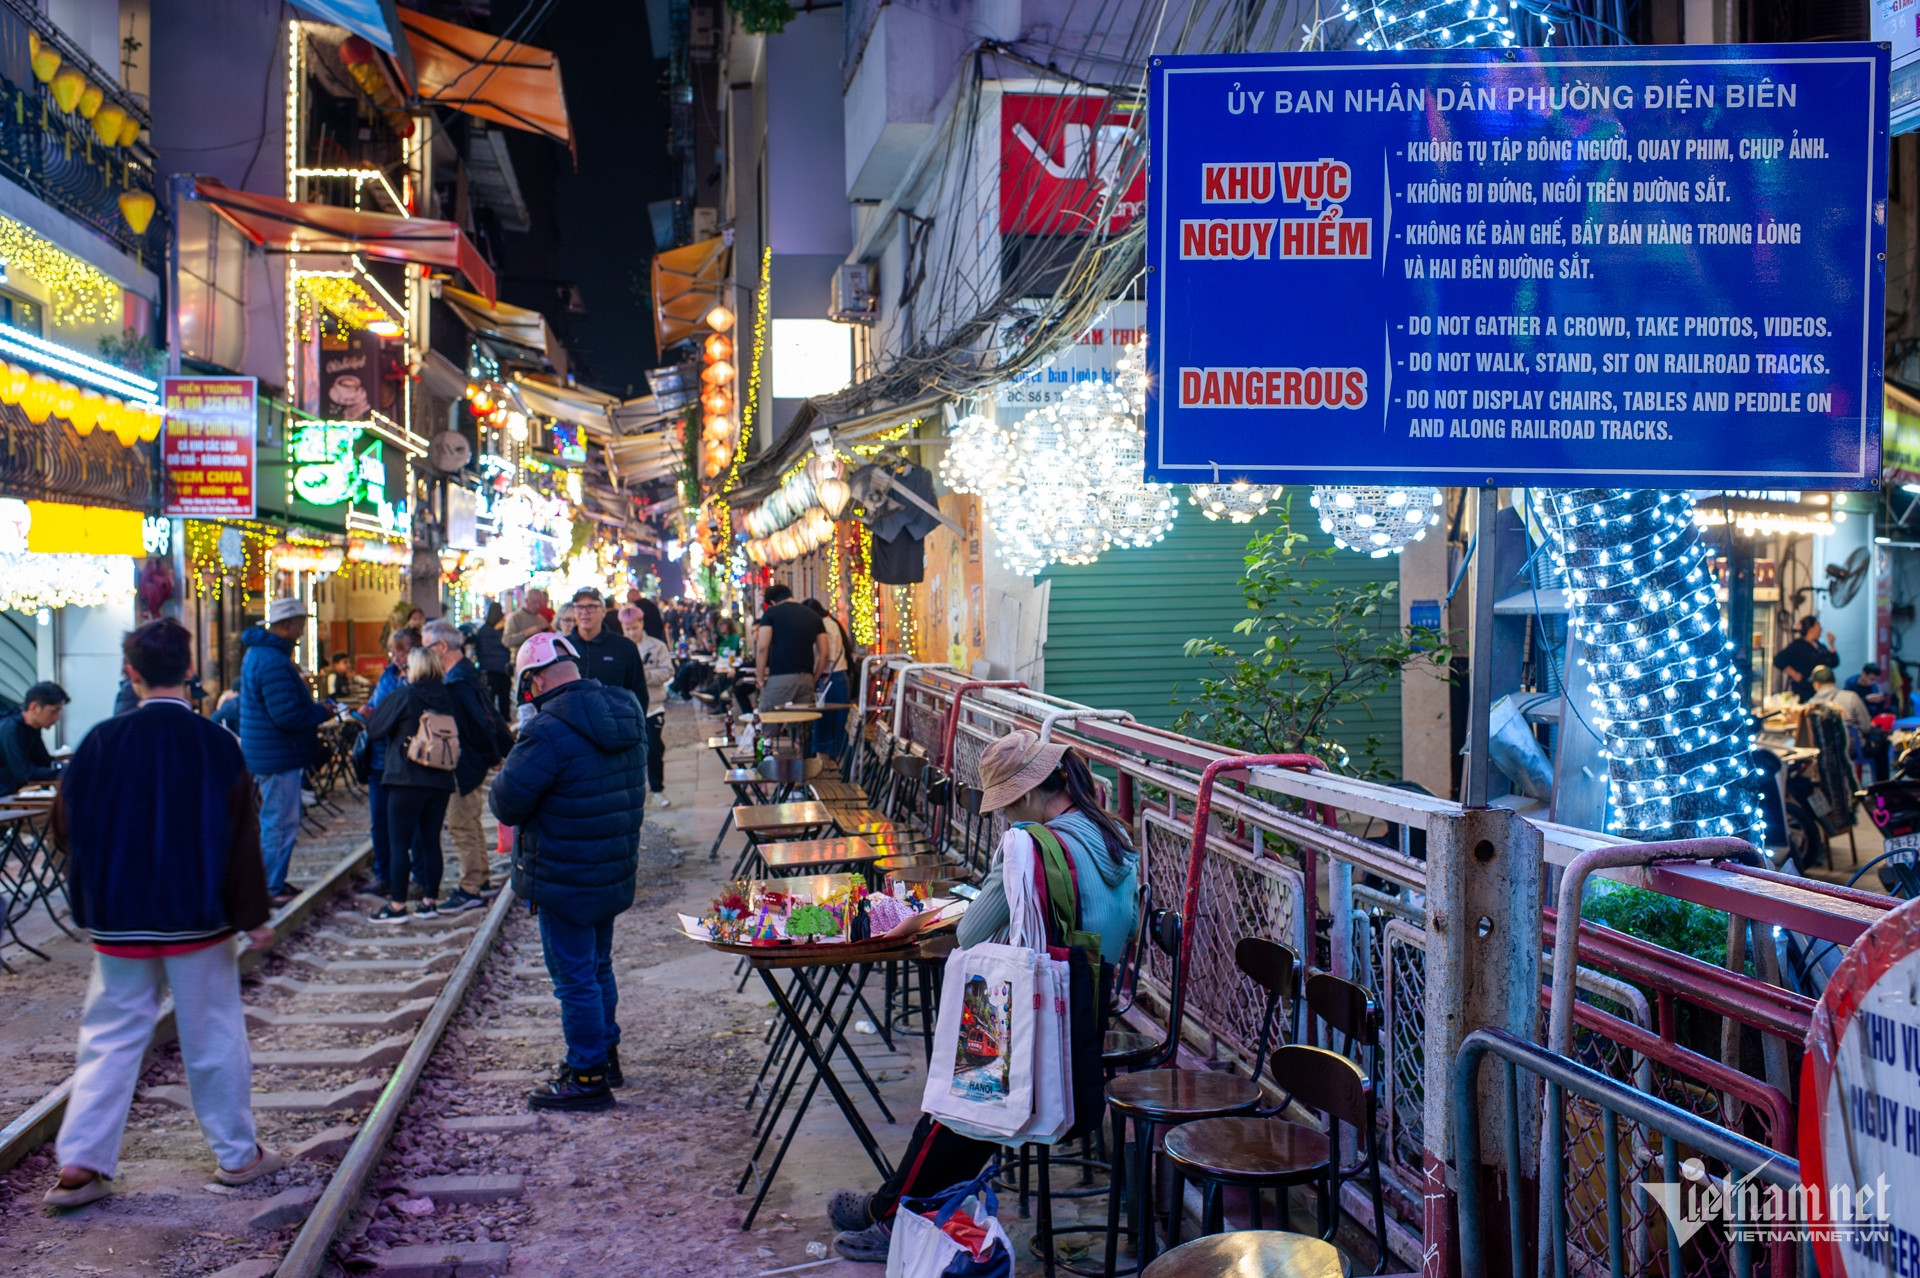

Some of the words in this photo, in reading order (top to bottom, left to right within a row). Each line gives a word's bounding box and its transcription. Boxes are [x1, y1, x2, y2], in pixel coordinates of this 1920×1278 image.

[1228, 82, 1265, 115] ỦY
[1275, 90, 1334, 113] BAN
[1345, 82, 1425, 112] NHÂN
[1436, 81, 1496, 111] DÂN
[1507, 79, 1634, 111] PHƯỜNG
[1644, 78, 1714, 114] ĐIỆN
[1726, 77, 1797, 108] BIÊN
[1407, 137, 1463, 162] KHÔNG
[1467, 140, 1487, 166] TỤ
[1491, 136, 1523, 166] TẬP
[1526, 136, 1573, 162] ĐÔNG
[1577, 134, 1633, 163] NGƯỜI,
[1637, 139, 1681, 163] QUAY
[1685, 138, 1734, 163] PHIM,
[1739, 138, 1785, 164] CHỤP
[1788, 129, 1830, 160] ẢNH.
[1203, 165, 1273, 202] KHU
[1281, 161, 1349, 207] VỰC
[1406, 179, 1462, 204] KHÔNG
[1466, 182, 1483, 203] ĐI
[1487, 176, 1537, 206] ĐỨNG,
[1542, 174, 1582, 203] NGỒI
[1586, 177, 1629, 203] TRÊN
[1632, 175, 1690, 203] ĐƯỜNG
[1694, 174, 1731, 203] SẮT.
[1183, 222, 1274, 257] NGUY
[1282, 207, 1369, 257] HIỂM
[1406, 219, 1461, 245] KHÔNG
[1466, 219, 1487, 245] KÊ
[1491, 218, 1525, 245] BÀN
[1530, 216, 1567, 248] GHẾ,
[1571, 216, 1604, 245] BẦY
[1608, 218, 1643, 245] BÁN
[1647, 218, 1693, 245] HÀNG
[1697, 223, 1753, 245] TRONG
[1757, 218, 1802, 245] LÒNG
[1404, 254, 1425, 279] VÀ
[1429, 258, 1457, 279] HAI
[1461, 254, 1494, 279] BÊN
[1498, 253, 1554, 279] ĐƯỜNG
[1559, 252, 1595, 279] SẮT.
[1408, 315, 1432, 336] DO
[1437, 315, 1471, 336] NOT
[1475, 315, 1541, 336] GATHER
[1545, 316, 1558, 336] A
[1563, 316, 1631, 339] CROWD,
[1635, 316, 1679, 337] TAKE
[1684, 316, 1758, 339] PHOTOS,
[1763, 316, 1833, 337] VIDEOS.
[1409, 352, 1432, 372] DO
[1437, 352, 1471, 372] NOT
[1475, 352, 1530, 375] WALK,
[1535, 352, 1597, 375] STAND,
[1602, 352, 1630, 373] SIT
[1634, 353, 1659, 373] ON
[1664, 353, 1750, 374] RAILROAD
[1755, 353, 1830, 375] TRACKS.
[1182, 370, 1364, 406] DANGEROUS
[1406, 389, 1429, 409] DO
[1434, 389, 1468, 410] NOT
[1472, 389, 1544, 410] DISPLAY
[1549, 390, 1618, 413] CHAIRS,
[1622, 391, 1688, 412] TABLES
[1692, 391, 1729, 412] AND
[1734, 392, 1801, 413] PEDDLE
[1806, 392, 1832, 413] ON
[1408, 418, 1445, 438] AND
[1449, 418, 1506, 439] ALONG
[1511, 419, 1595, 440] RAILROAD
[1600, 420, 1673, 441] TRACKS.
[969, 1080, 993, 1095] HANOI
[1850, 1083, 1898, 1147] NGUY
